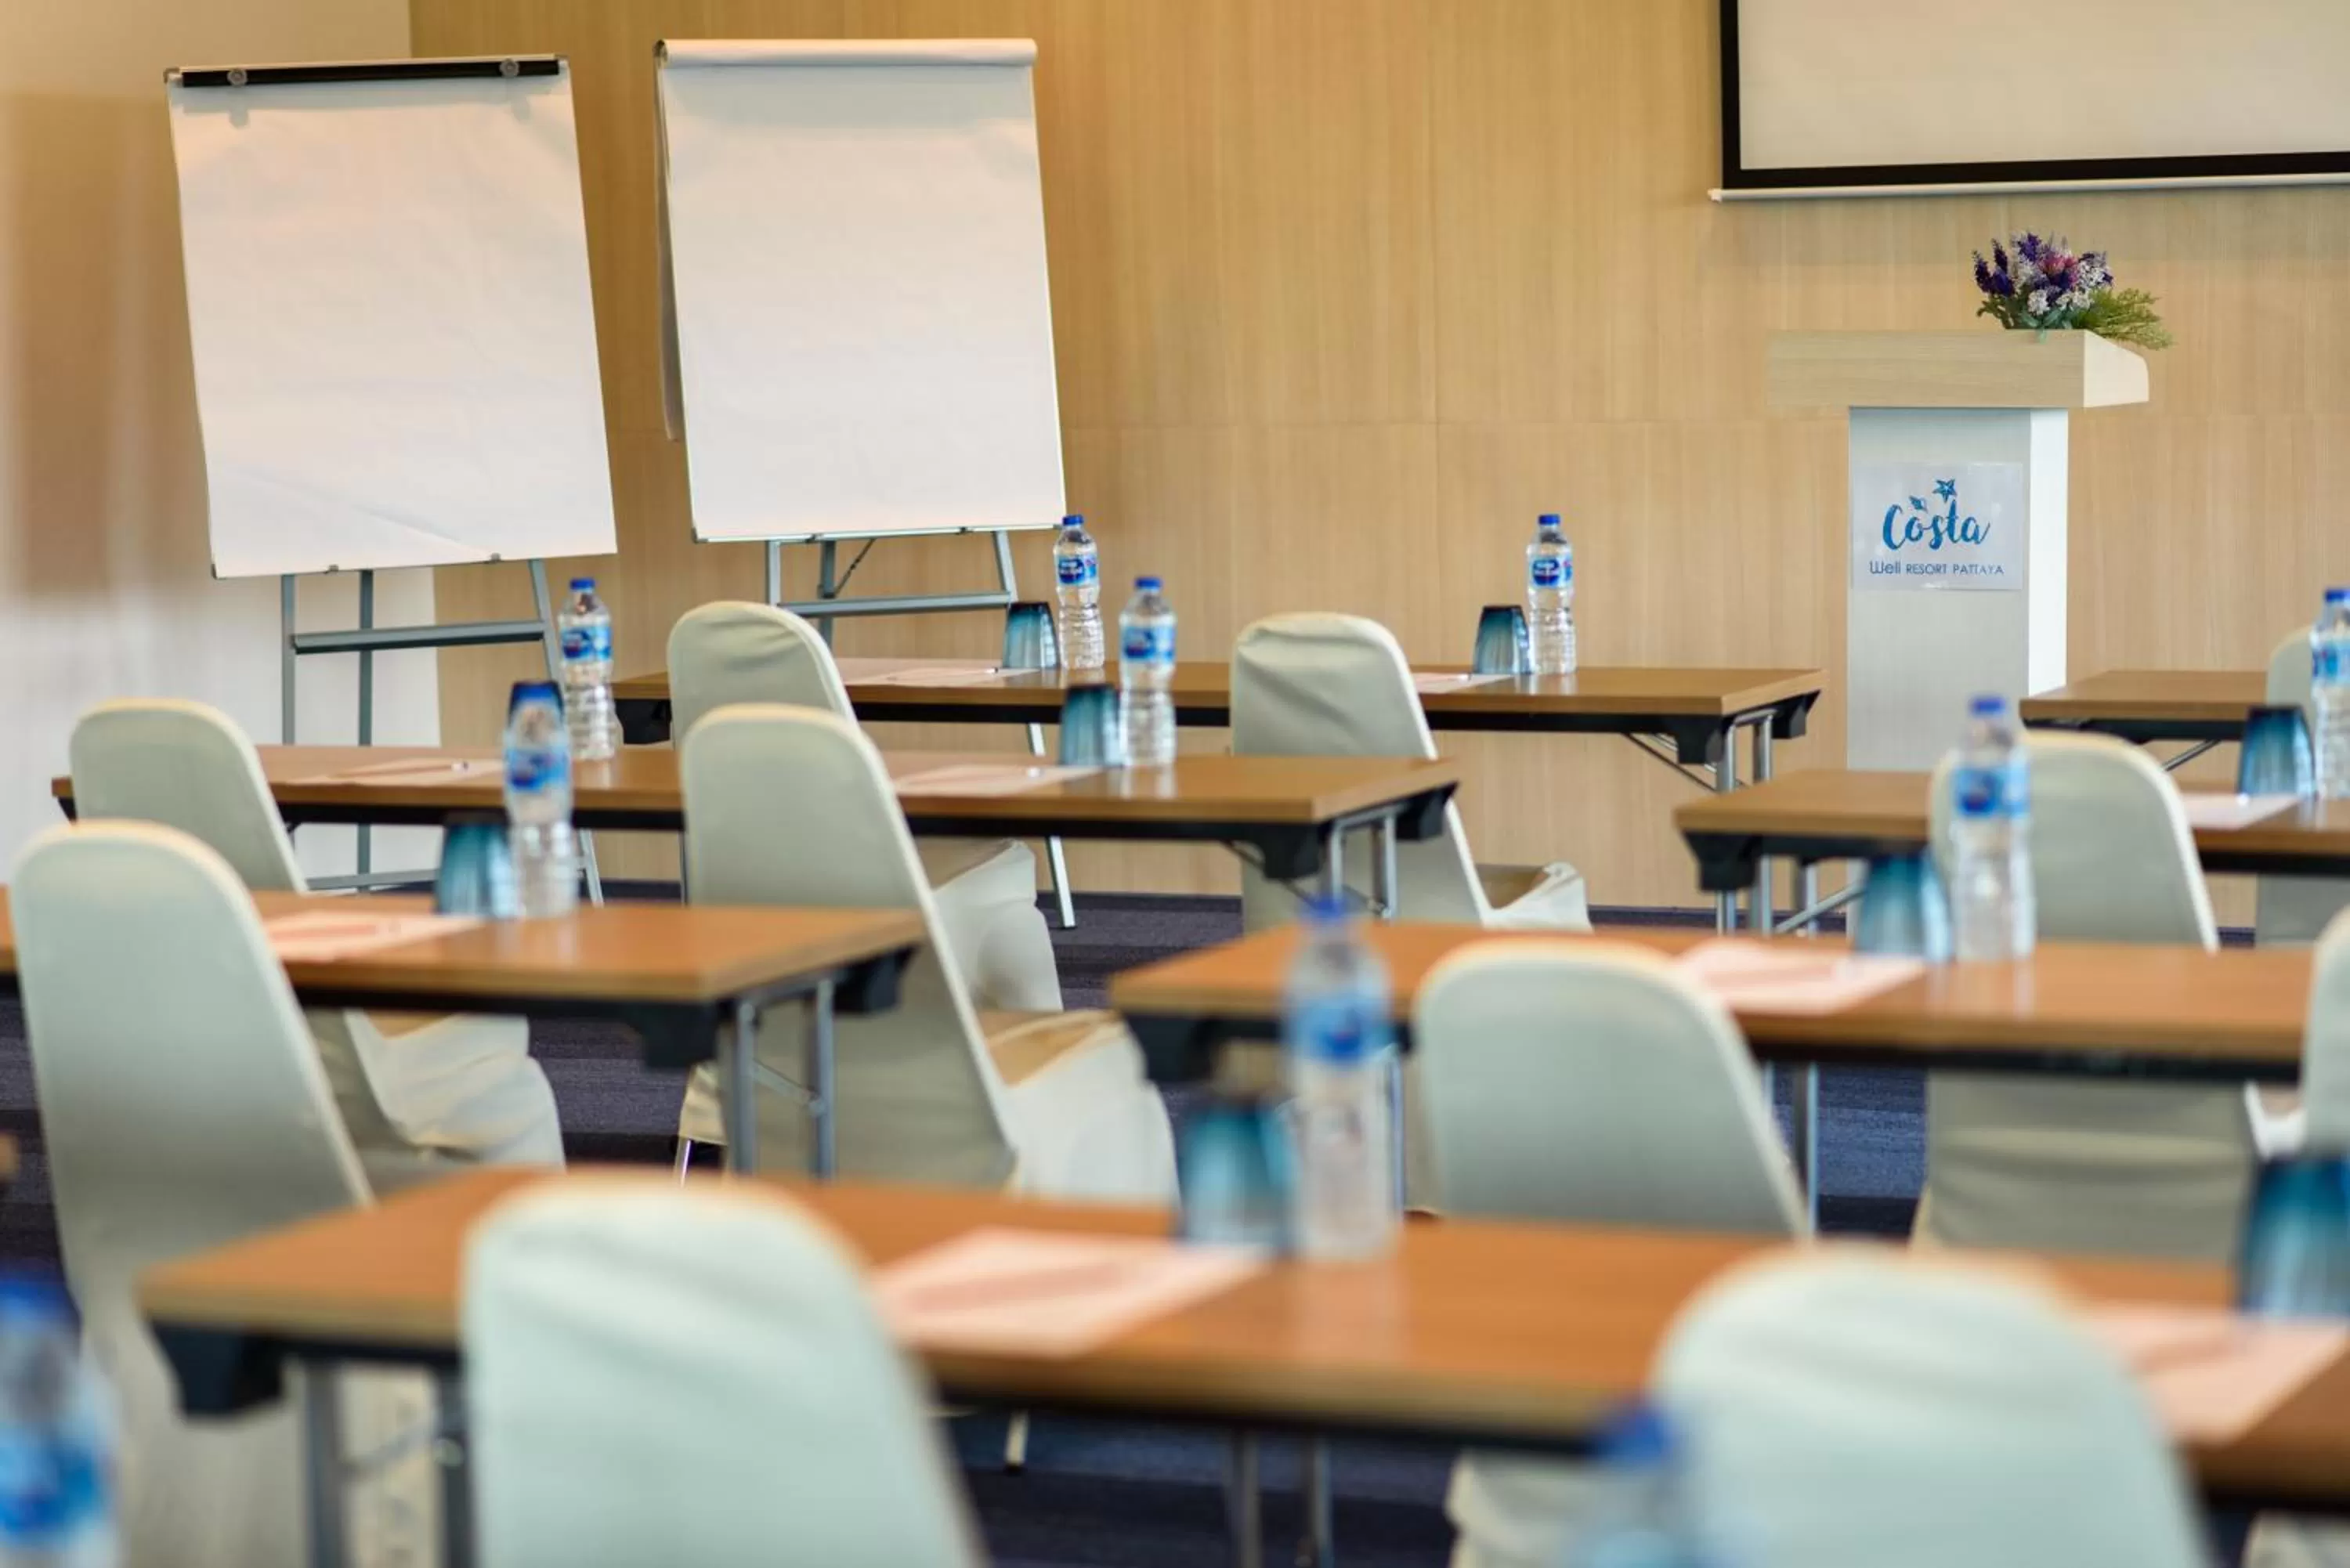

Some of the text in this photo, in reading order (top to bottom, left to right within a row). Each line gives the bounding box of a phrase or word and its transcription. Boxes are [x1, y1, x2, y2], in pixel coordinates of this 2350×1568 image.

[1882, 499, 1990, 550] Costa
[1869, 560, 2005, 575] Well RESORT PATTAYA
